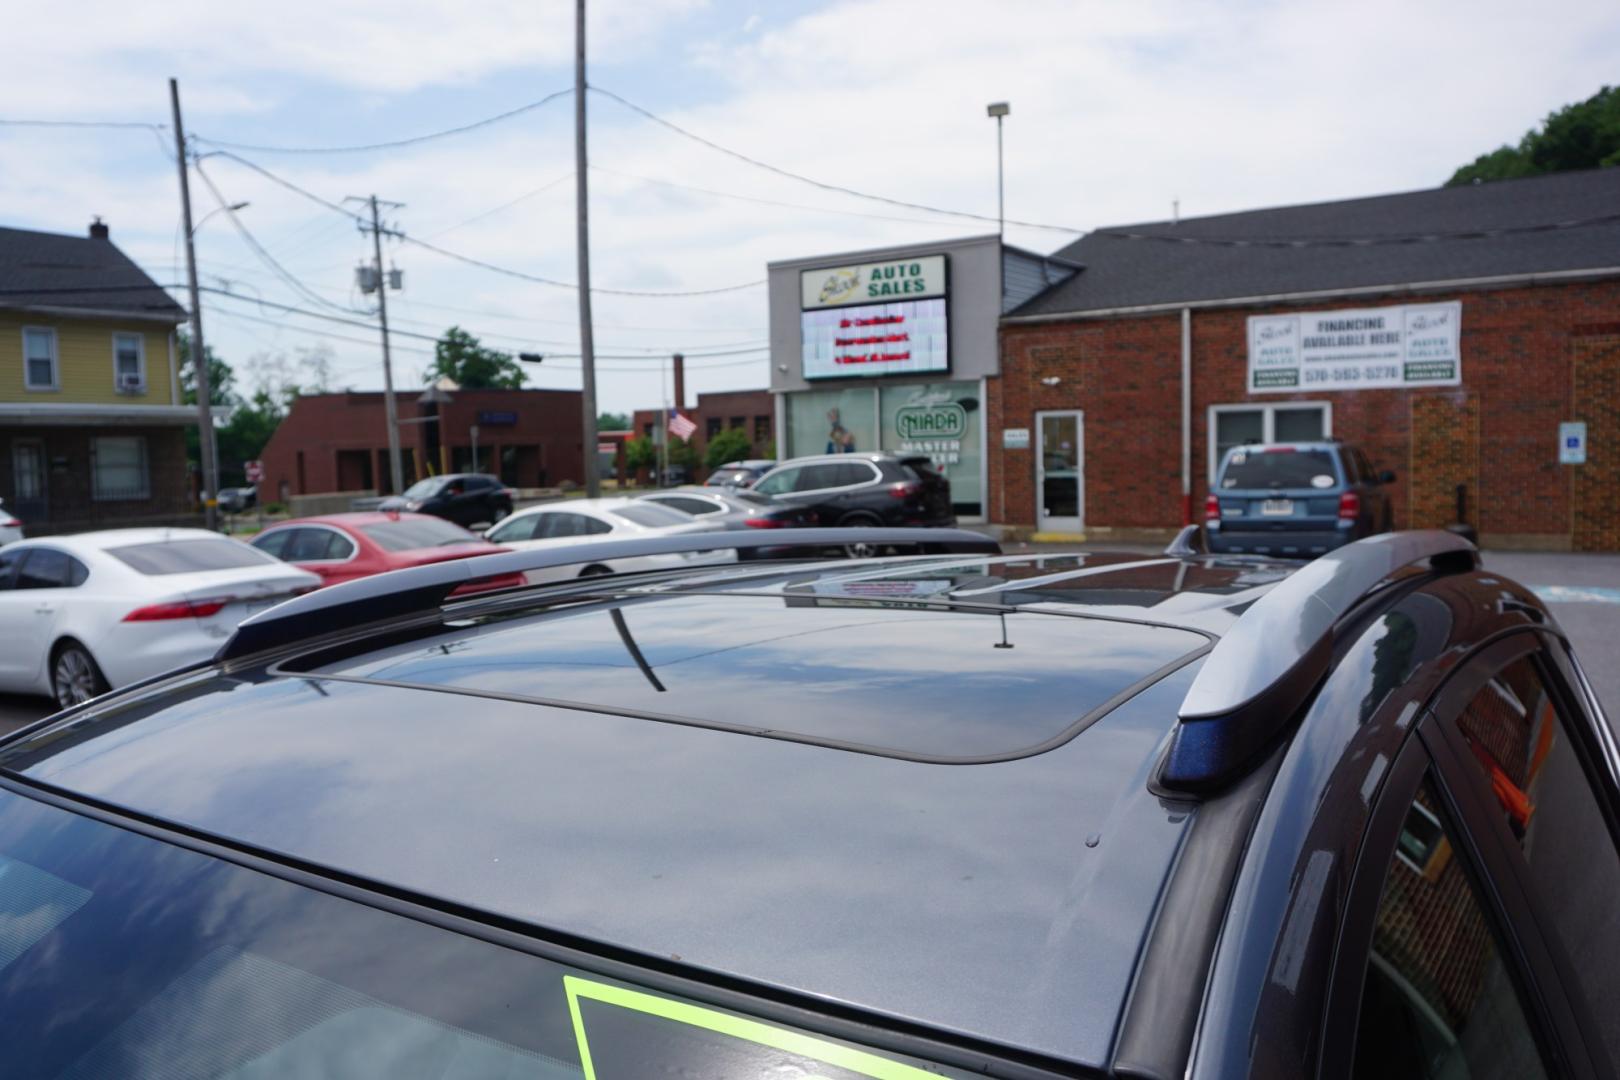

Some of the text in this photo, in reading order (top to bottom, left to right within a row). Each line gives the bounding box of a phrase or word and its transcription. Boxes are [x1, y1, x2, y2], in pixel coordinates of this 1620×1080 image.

[871, 263, 921, 281] AUTO
[868, 279, 926, 297] SALES
[1317, 317, 1385, 332] FINANCING
[1303, 333, 1365, 348] AVAILABLE
[902, 412, 958, 430] NIADA
[901, 440, 960, 453] MASTER
